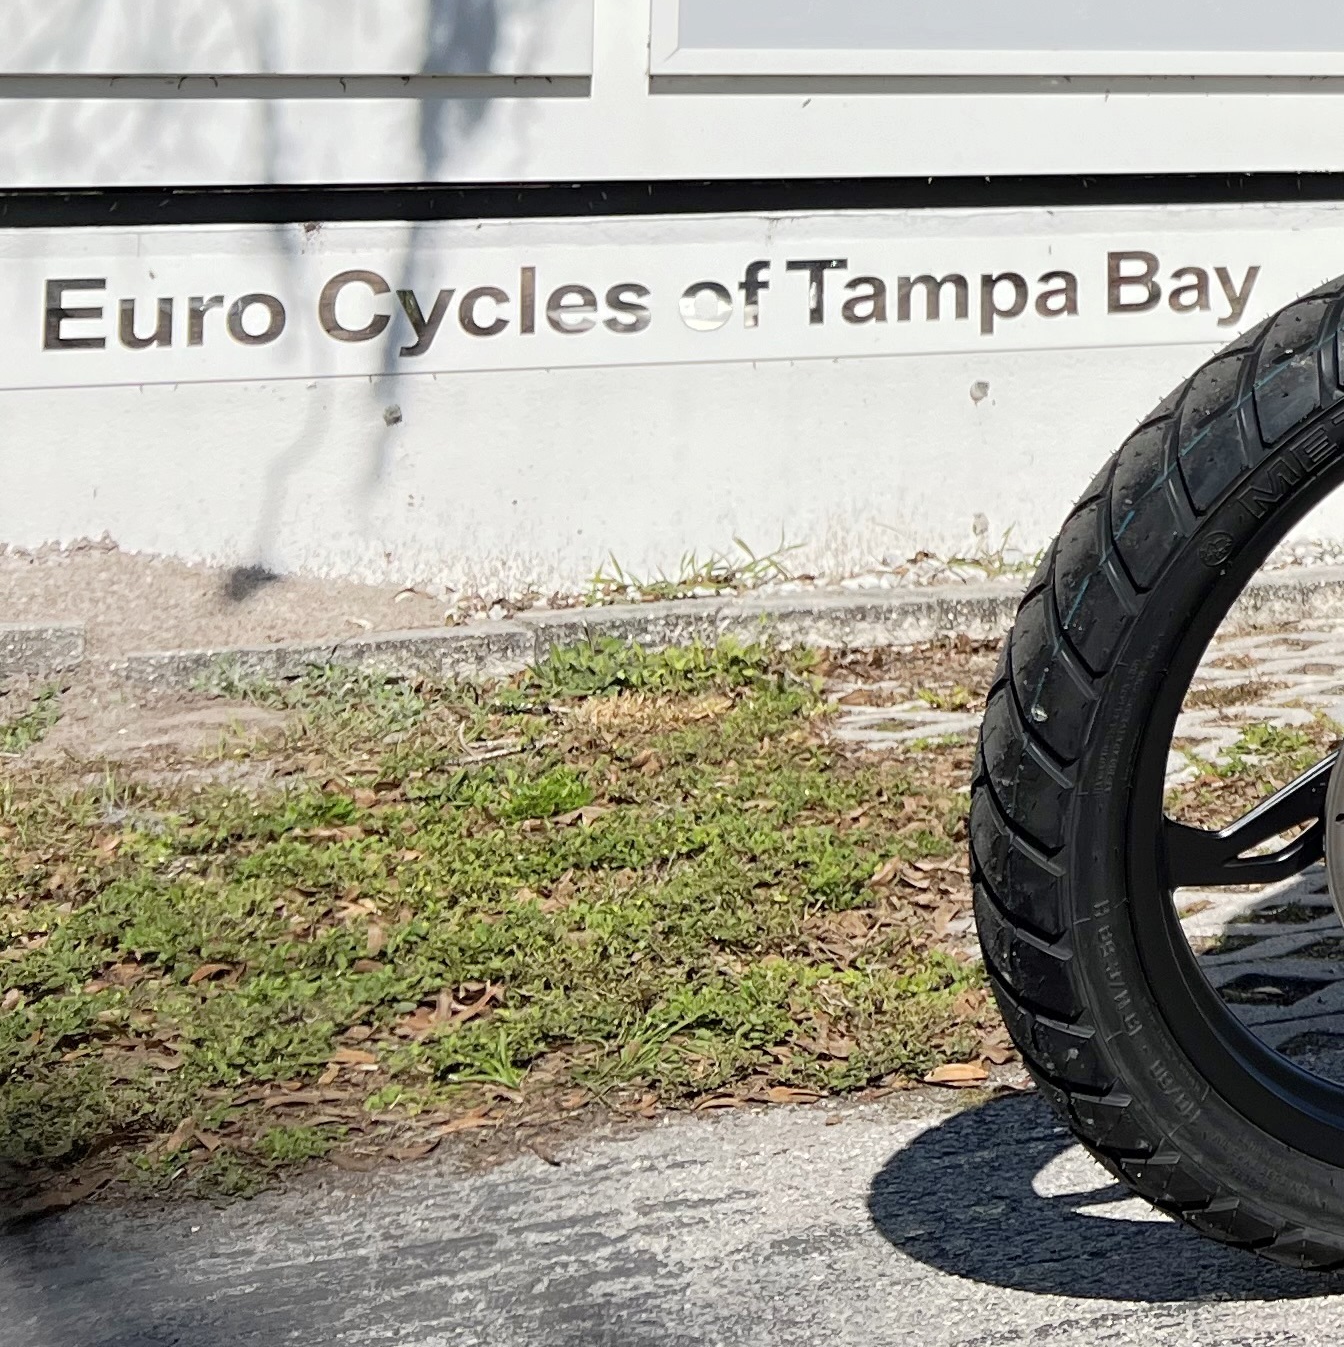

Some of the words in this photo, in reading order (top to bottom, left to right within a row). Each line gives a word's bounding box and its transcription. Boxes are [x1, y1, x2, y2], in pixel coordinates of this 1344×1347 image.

[41, 276, 288, 352] Euro
[317, 264, 653, 358] Cycles
[678, 260, 767, 333] of
[785, 258, 1081, 336] Tampa
[1105, 250, 1262, 326] Bay
